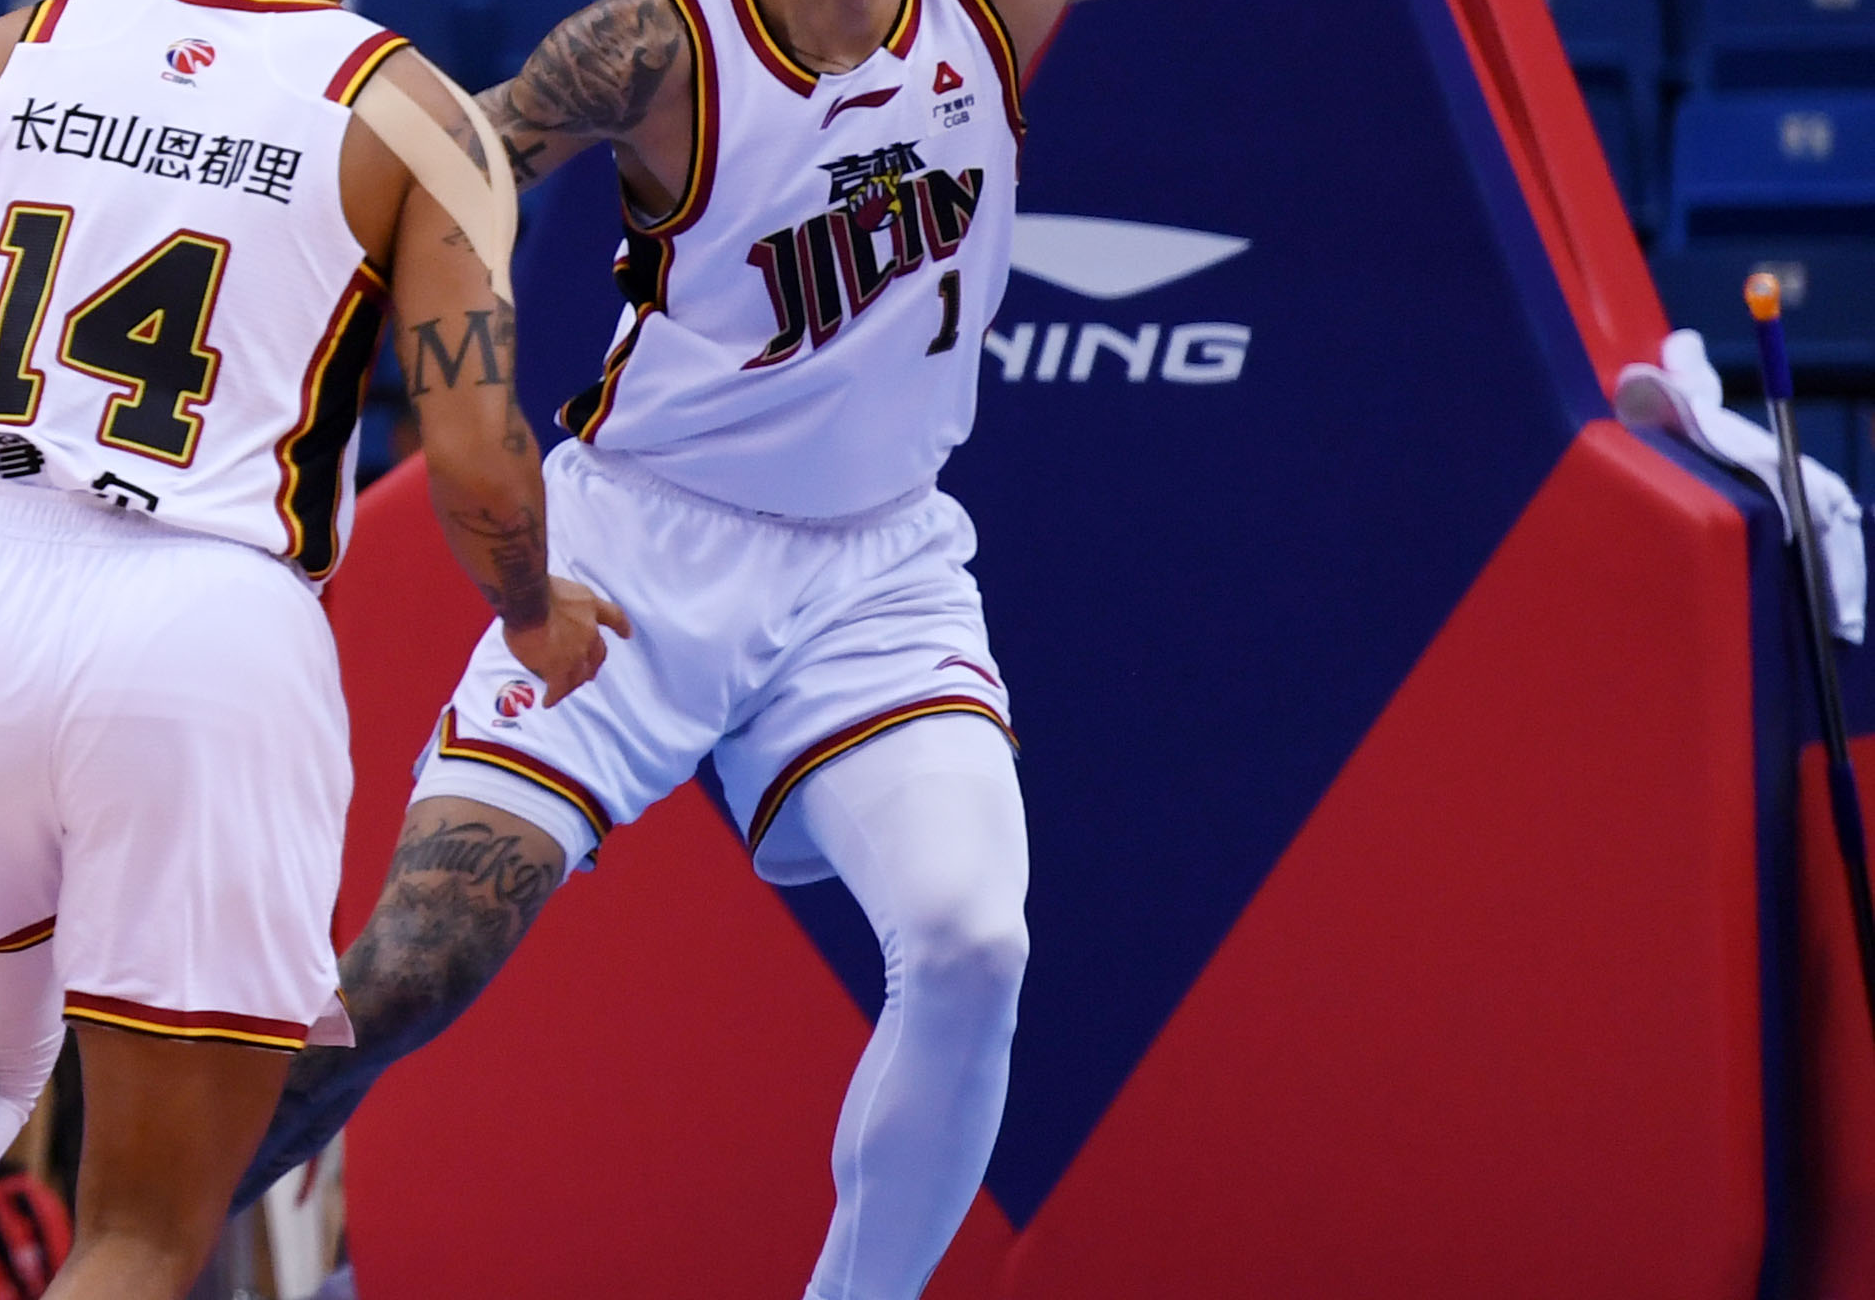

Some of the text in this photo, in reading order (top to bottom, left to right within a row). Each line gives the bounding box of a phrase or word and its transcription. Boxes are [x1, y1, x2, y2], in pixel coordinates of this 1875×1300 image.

[11, 96, 303, 204] 长白山恩都里
[740, 167, 984, 371] JILIN
[926, 269, 960, 356] 1
